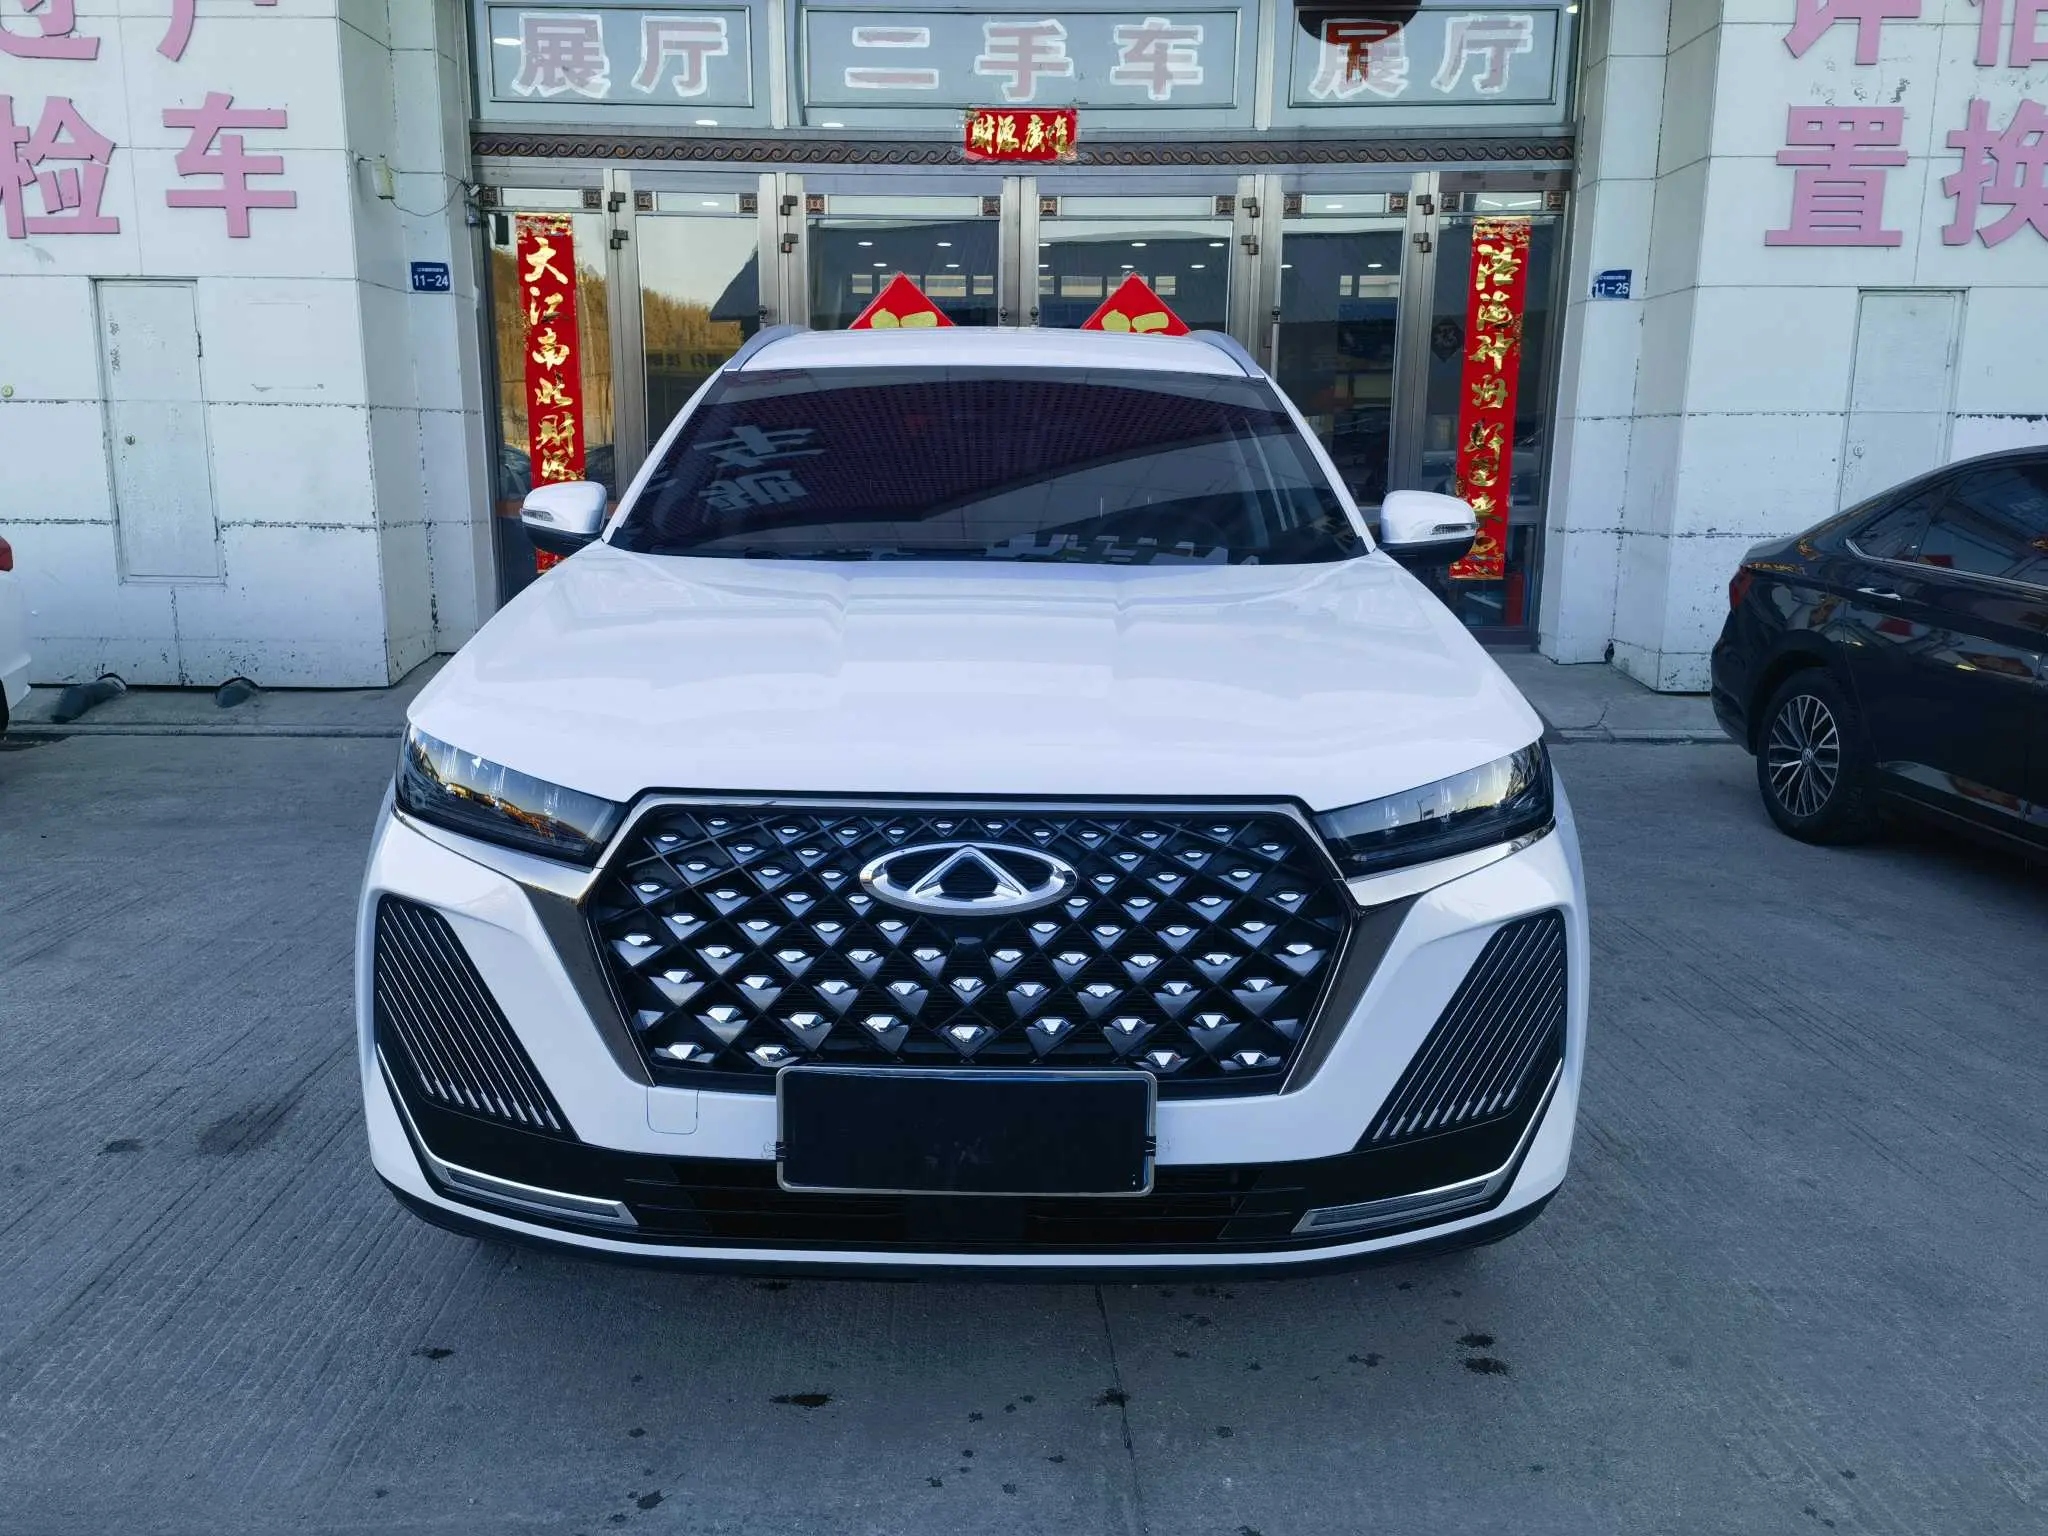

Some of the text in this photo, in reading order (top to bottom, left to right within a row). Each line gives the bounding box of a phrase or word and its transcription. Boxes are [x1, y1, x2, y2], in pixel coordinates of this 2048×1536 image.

[512, 13, 729, 98] 展厅
[844, 17, 1205, 102] 二手车
[1309, 14, 1534, 99] 展厅
[0, 92, 297, 238] 检车
[1765, 98, 2048, 249] 置换
[413, 274, 449, 287] 11-24
[1593, 282, 1630, 295] 11-25
